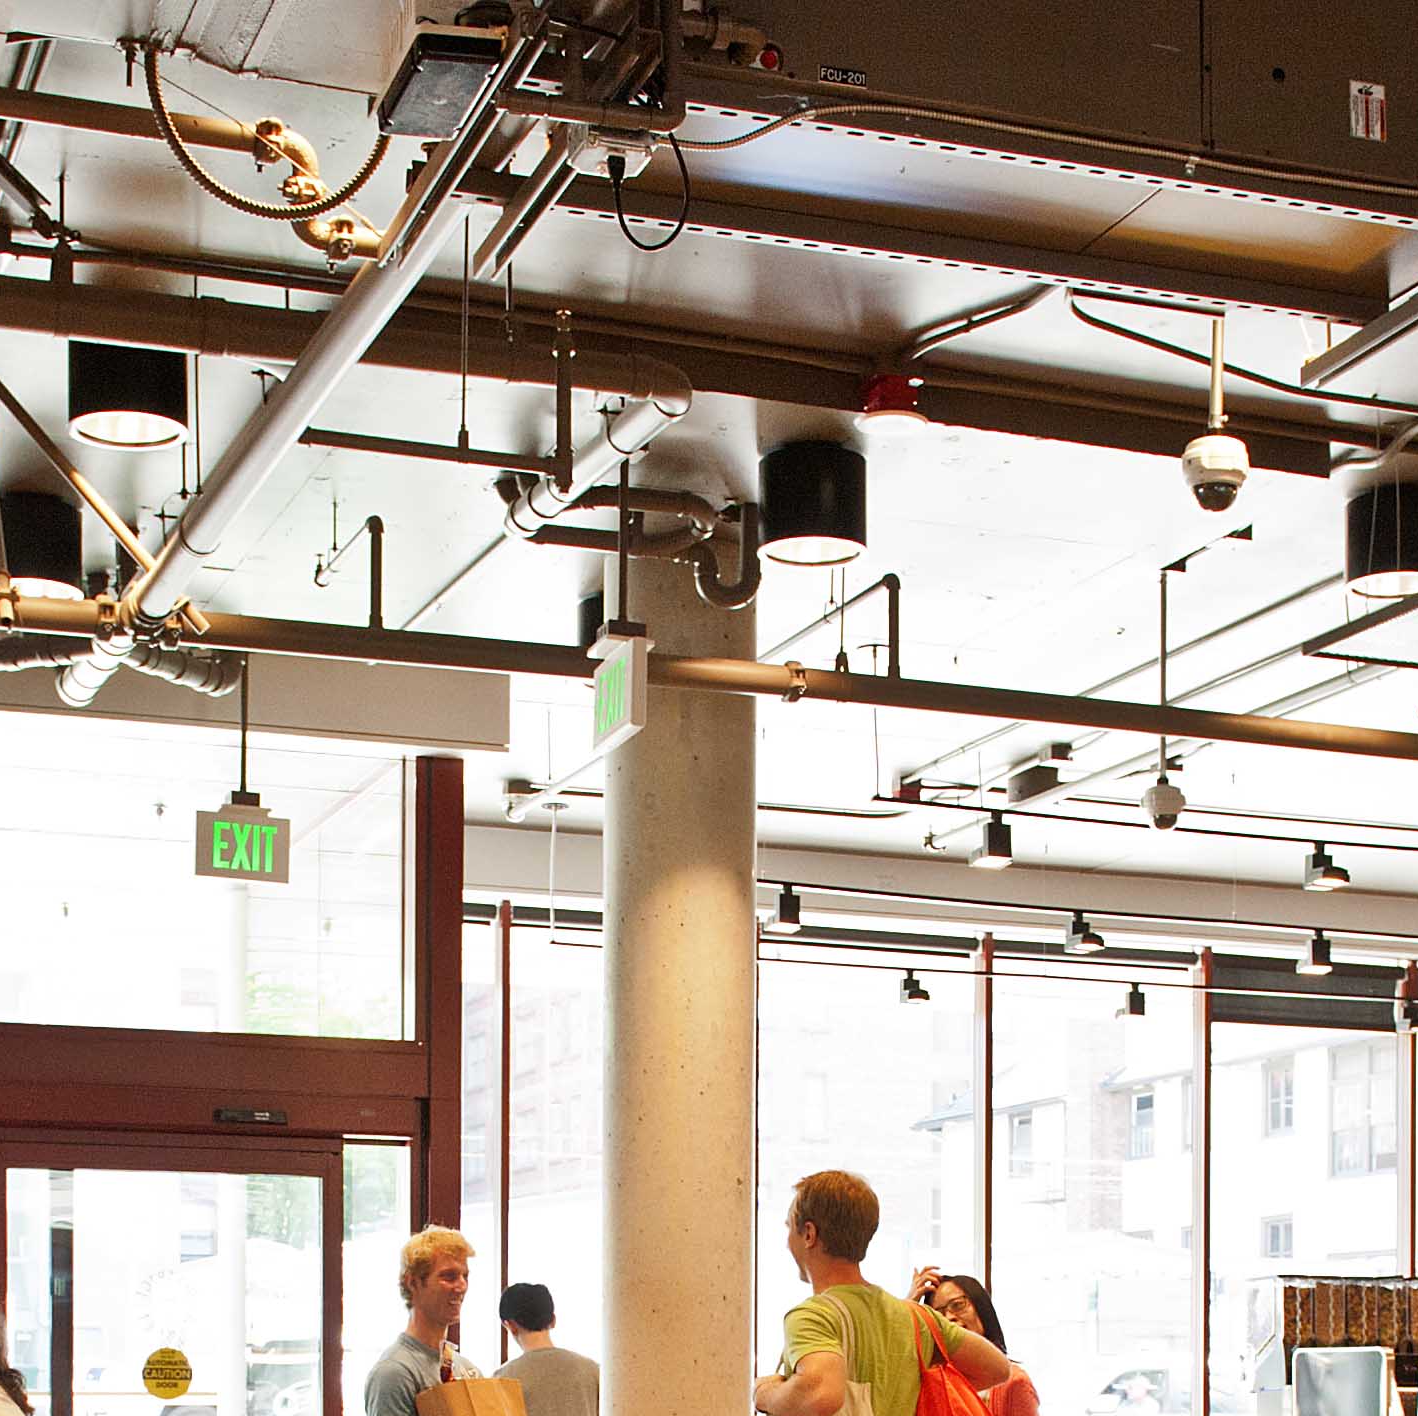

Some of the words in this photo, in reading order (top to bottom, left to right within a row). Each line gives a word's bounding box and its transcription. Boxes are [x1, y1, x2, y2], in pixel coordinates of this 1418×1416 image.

[595, 656, 628, 735] EXIT
[212, 821, 278, 873] EXIT
[143, 1368, 192, 1380] CAUTION
[155, 1381, 179, 1389] DOOR
